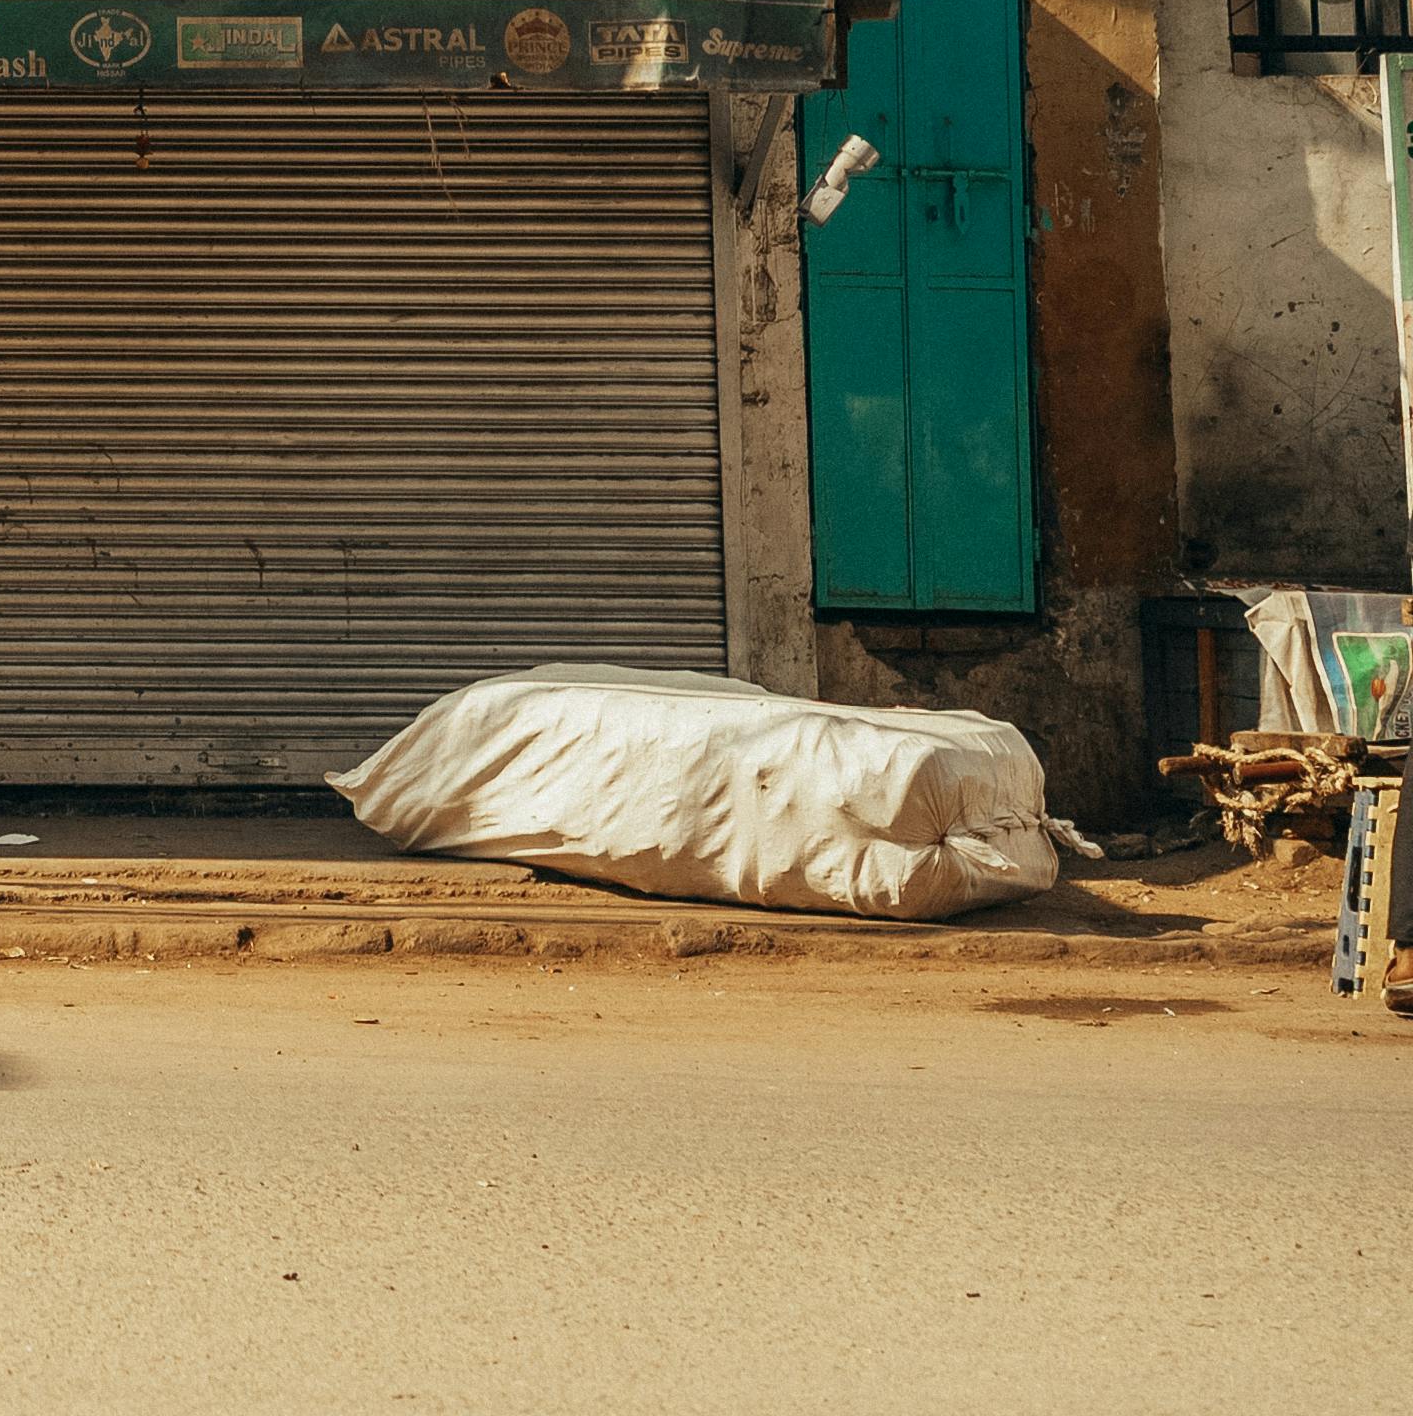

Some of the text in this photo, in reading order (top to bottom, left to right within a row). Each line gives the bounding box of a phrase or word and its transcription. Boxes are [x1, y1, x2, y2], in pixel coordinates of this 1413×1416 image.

[207, 27, 297, 54] JINDAL
[361, 23, 486, 53] ASTRAL
[596, 22, 681, 43] TATA
[507, 40, 568, 54] PRINCE
[598, 45, 682, 60] PIPES
[701, 26, 805, 65] Supreme
[439, 54, 486, 69] PIPES
